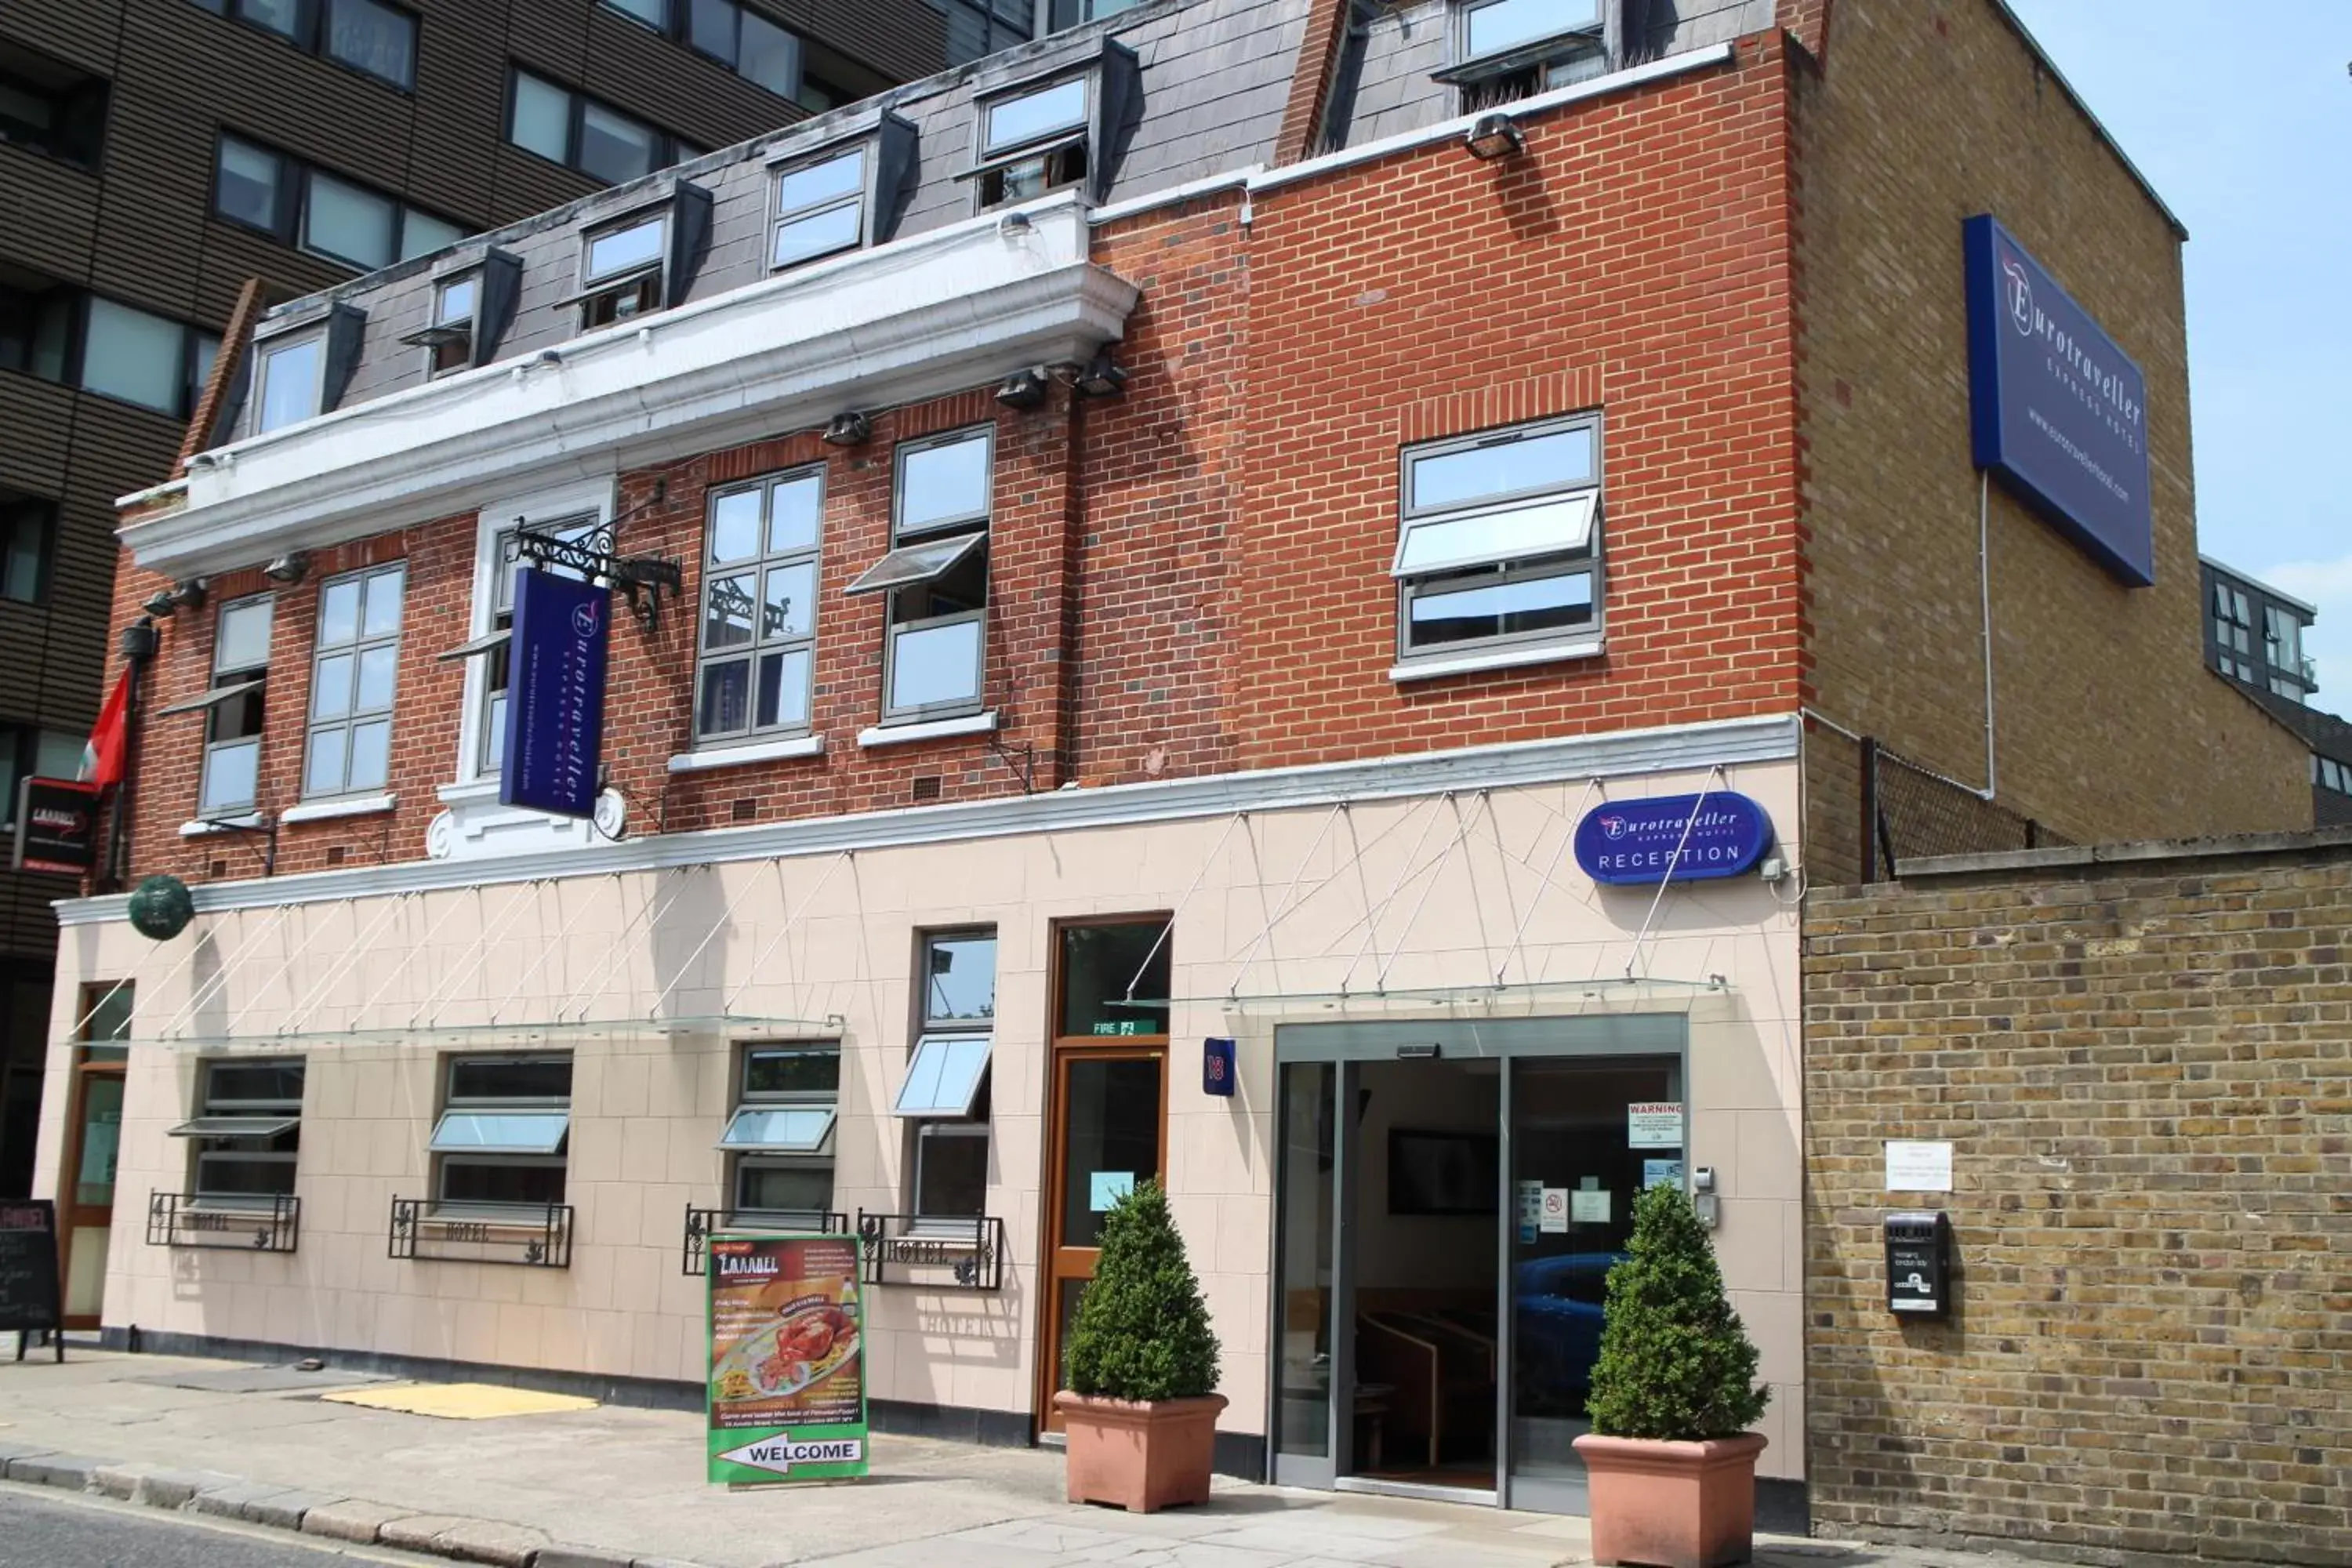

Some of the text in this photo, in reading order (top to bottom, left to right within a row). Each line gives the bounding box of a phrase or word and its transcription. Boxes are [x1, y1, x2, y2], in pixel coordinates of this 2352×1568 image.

[2005, 259, 2141, 426] Eurotraveller
[2106, 415, 2141, 455] HOTEL
[566, 601, 598, 803] Eurotraveller
[1603, 812, 1737, 840] Eurotraveller
[1599, 846, 1739, 869] RECEPTION
[1094, 1022, 1115, 1035] FIRE
[446, 1222, 489, 1243] HOTEL
[750, 1443, 854, 1462] WELCOME
